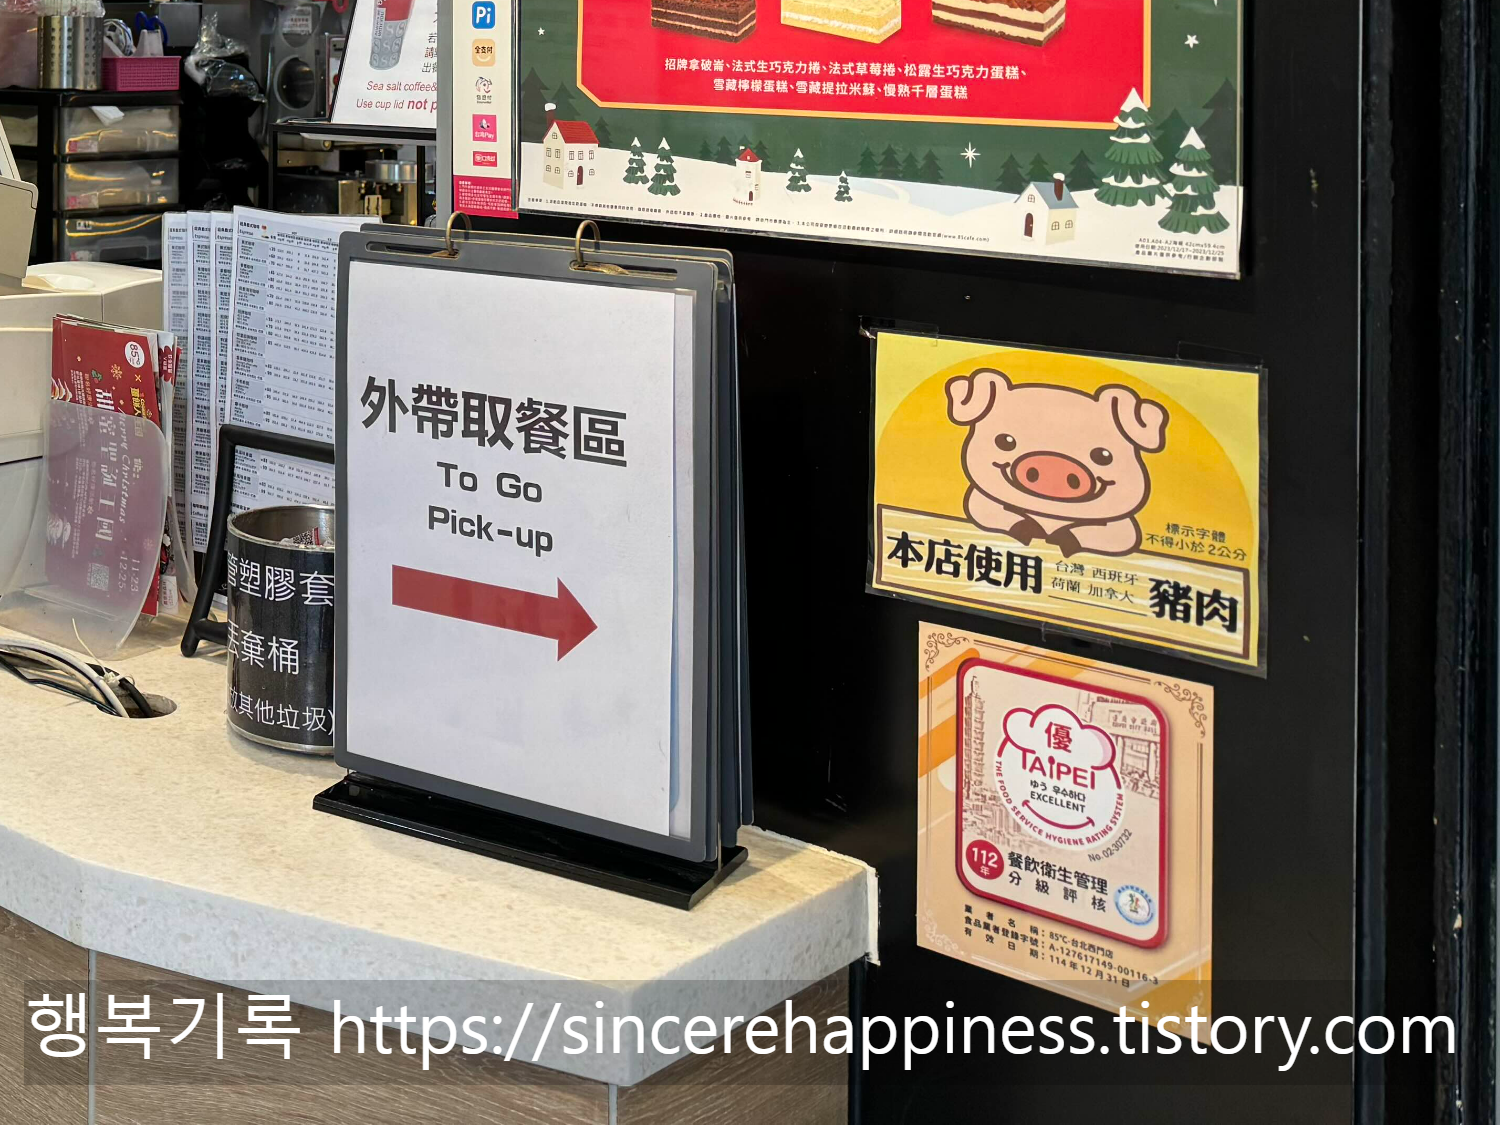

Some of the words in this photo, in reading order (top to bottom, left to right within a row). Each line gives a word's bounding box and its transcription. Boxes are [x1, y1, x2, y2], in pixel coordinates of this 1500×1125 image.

[476, 6, 491, 24] Pi
[366, 80, 384, 91] Sea
[386, 80, 402, 91] salt
[356, 98, 373, 109] Use
[375, 100, 392, 111] cup
[393, 99, 405, 110] lid
[407, 100, 428, 110] not
[359, 374, 627, 469] 外帶取餐區
[118, 455, 130, 524] Christmas
[436, 461, 478, 493] To
[495, 472, 543, 504] Go
[427, 503, 554, 556] Pick-up
[1165, 521, 1227, 544] 標示字體
[885, 531, 1044, 594] 本店使用
[1055, 559, 1085, 577] 台灣
[1092, 566, 1139, 587] 西班牙
[1050, 576, 1081, 594] 荷蘭
[1088, 582, 1135, 604] 加拿大
[1148, 577, 1239, 633] 豬肉
[228, 684, 334, 736] 放其他垃圾)
[1045, 721, 1072, 753] 優
[995, 760, 1003, 777] THE
[998, 779, 1013, 805] FOOD
[1030, 779, 1047, 791] ゆう
[1052, 785, 1086, 803] 우수하다
[1030, 790, 1086, 813] EXCELLENT
[1011, 805, 1044, 836] SERVICE
[1110, 792, 1124, 826] SYSTEM
[1045, 832, 1085, 846] HYGIENE
[1086, 825, 1113, 844] RATING
[1088, 852, 1103, 863] No.
[1103, 828, 1133, 858] 02-30732
[972, 846, 999, 868] 112
[980, 865, 990, 876] 年
[1008, 851, 1108, 896] 餐飲衛生管理
[1049, 944, 1159, 985] A-127617149-00116-3
